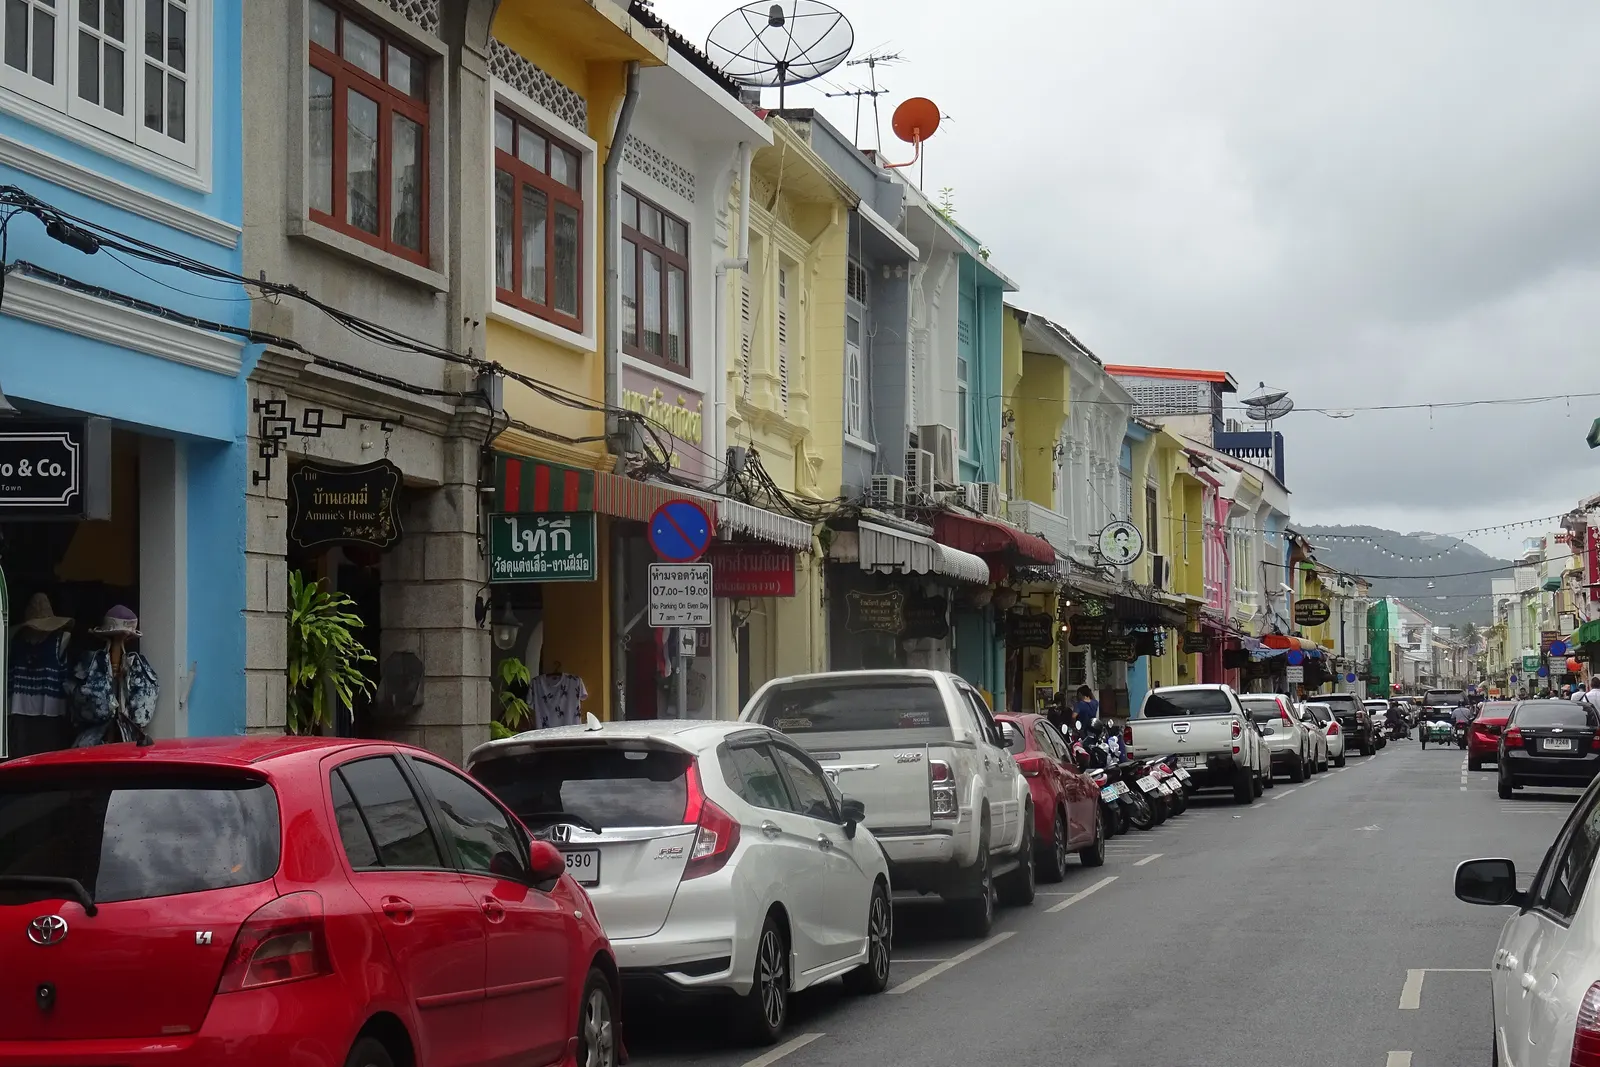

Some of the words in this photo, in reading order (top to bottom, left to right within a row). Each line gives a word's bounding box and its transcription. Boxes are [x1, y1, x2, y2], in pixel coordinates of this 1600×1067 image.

[18, 459, 32, 477] &
[37, 459, 67, 477] Co.
[313, 483, 368, 505] บ้านเอมมี่
[305, 510, 345, 520] Ammie's
[348, 510, 376, 520] Home
[651, 568, 709, 585] ห้ามจอดวันคู่
[660, 602, 677, 610] Parking
